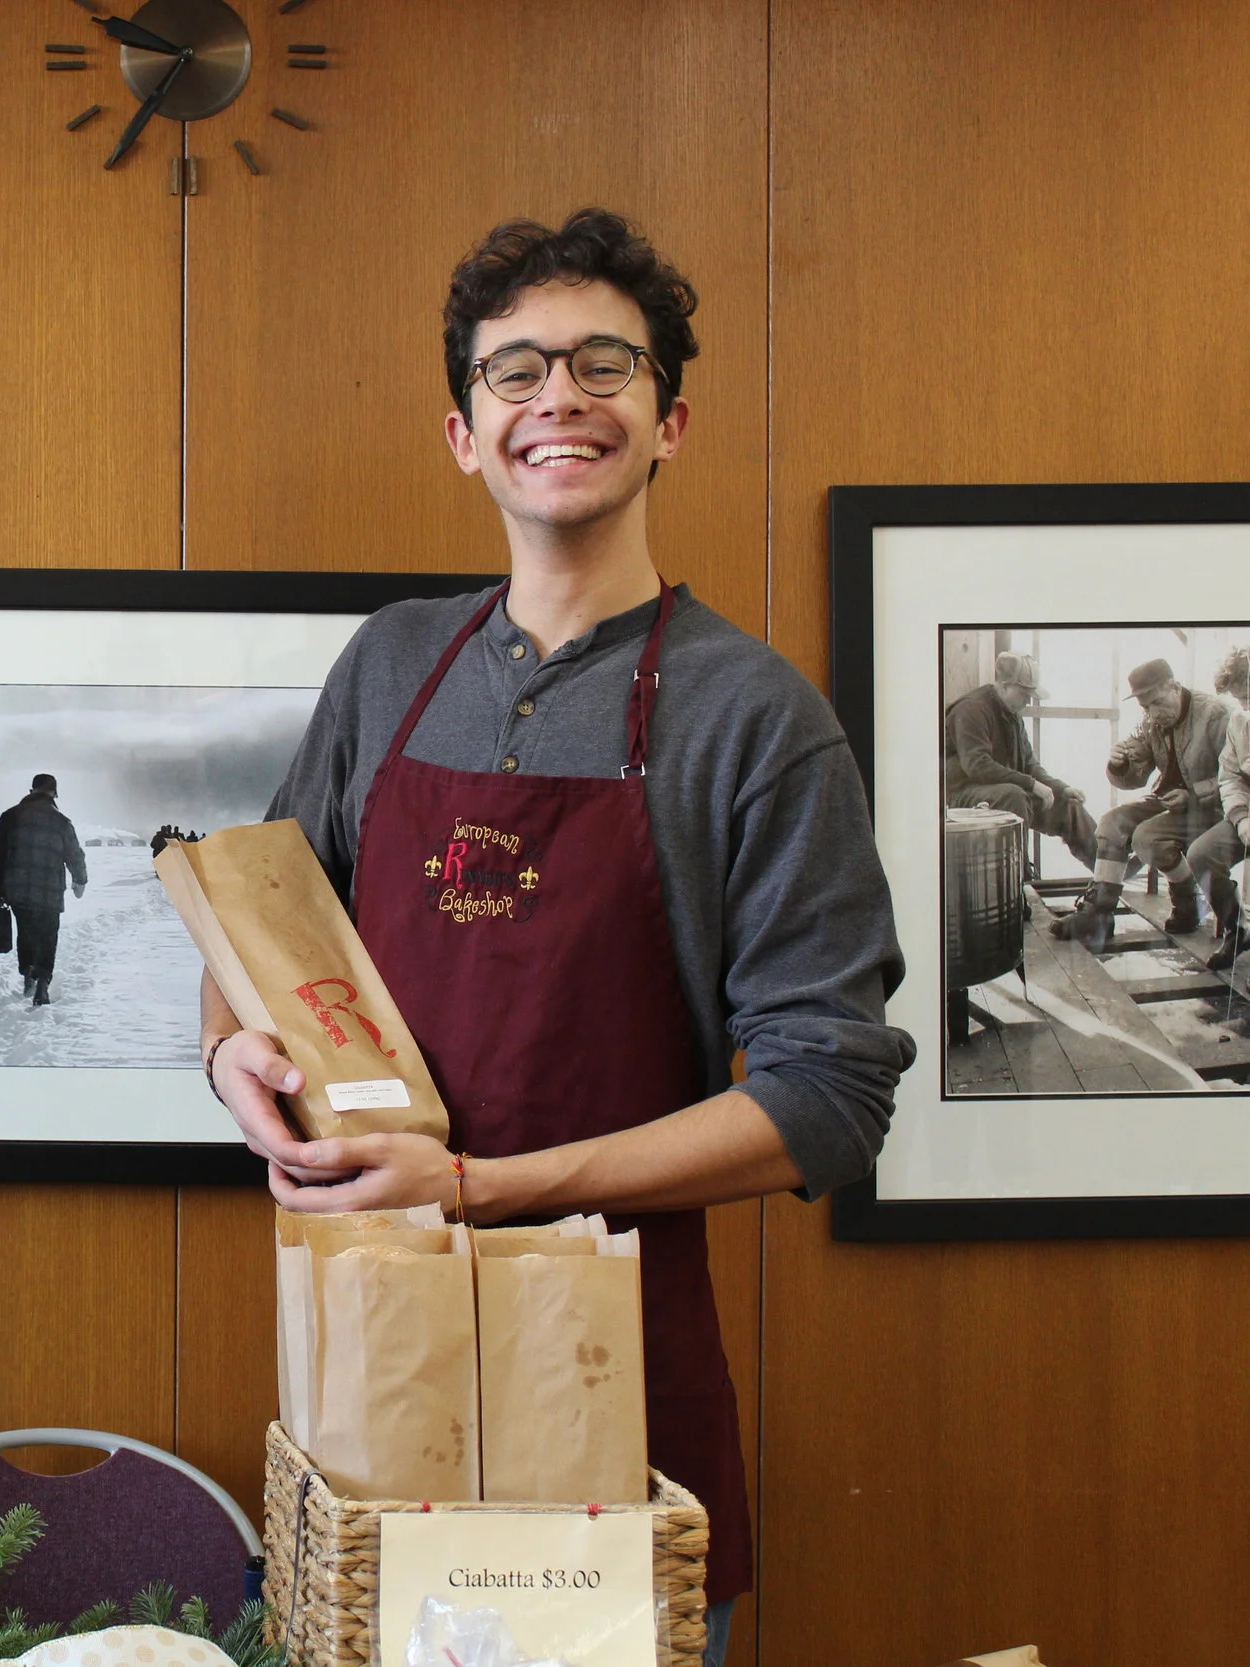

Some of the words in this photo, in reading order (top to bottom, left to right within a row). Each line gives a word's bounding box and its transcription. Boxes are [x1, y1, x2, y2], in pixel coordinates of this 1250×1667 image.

[453, 817, 519, 854] European
[439, 888, 513, 923] Bakeshop
[448, 1568, 534, 1588] Ciabatta
[541, 1568, 600, 1589] $3.00
